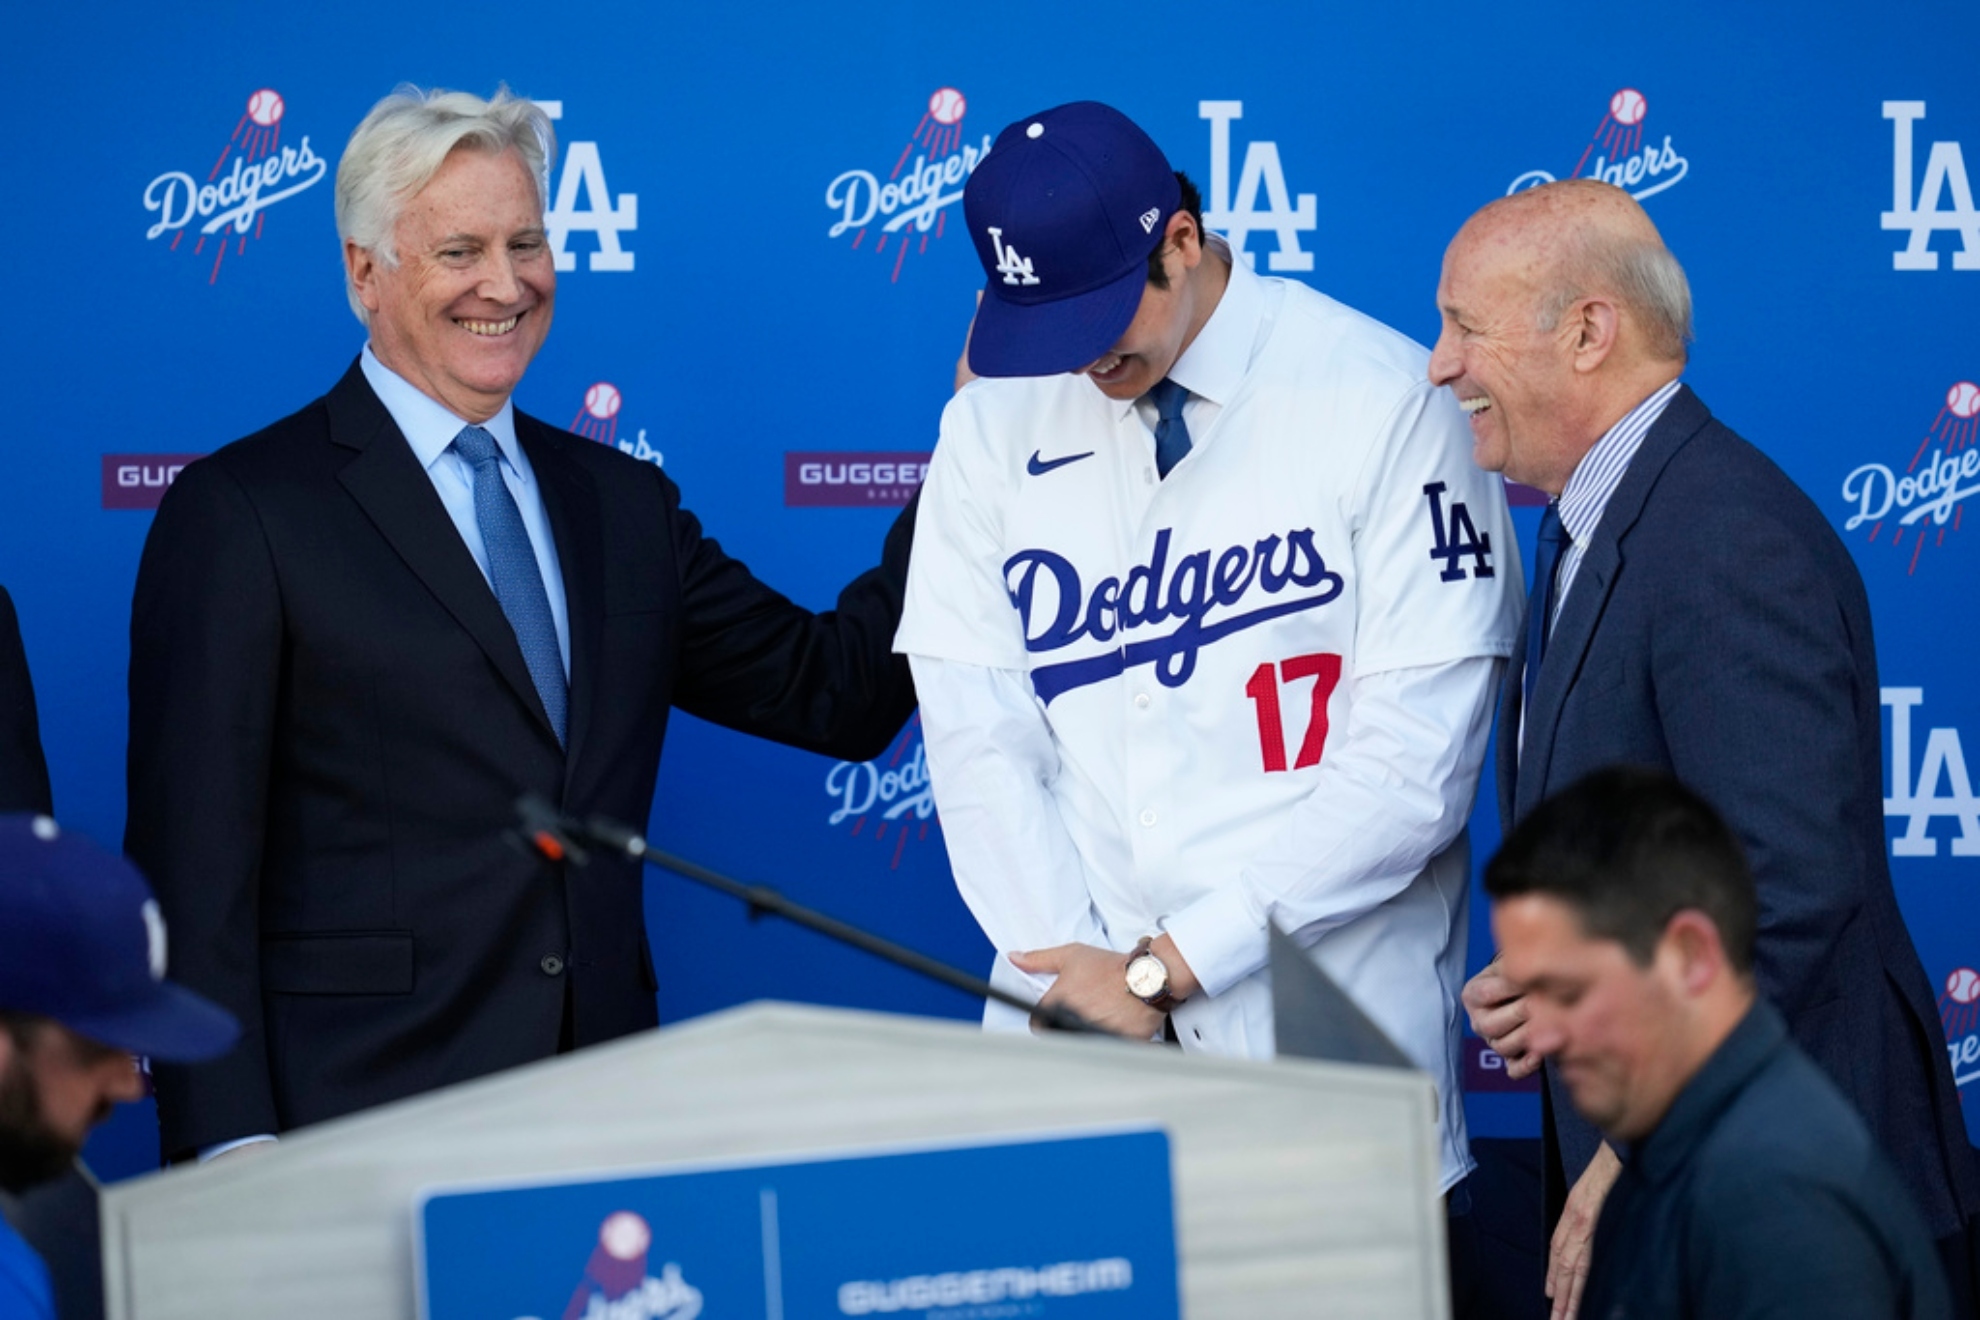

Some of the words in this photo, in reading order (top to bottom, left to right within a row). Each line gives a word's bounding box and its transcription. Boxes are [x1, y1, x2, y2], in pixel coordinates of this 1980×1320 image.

[143, 135, 327, 240] Dodgers
[532, 100, 638, 271] A
[987, 226, 1041, 286] LA
[1199, 100, 1317, 271] LA
[1881, 101, 1980, 270] LA
[1423, 481, 1495, 582] LA
[1003, 527, 1344, 709] Dodgers
[1245, 652, 1342, 773] 17
[1880, 687, 1980, 857] LA
